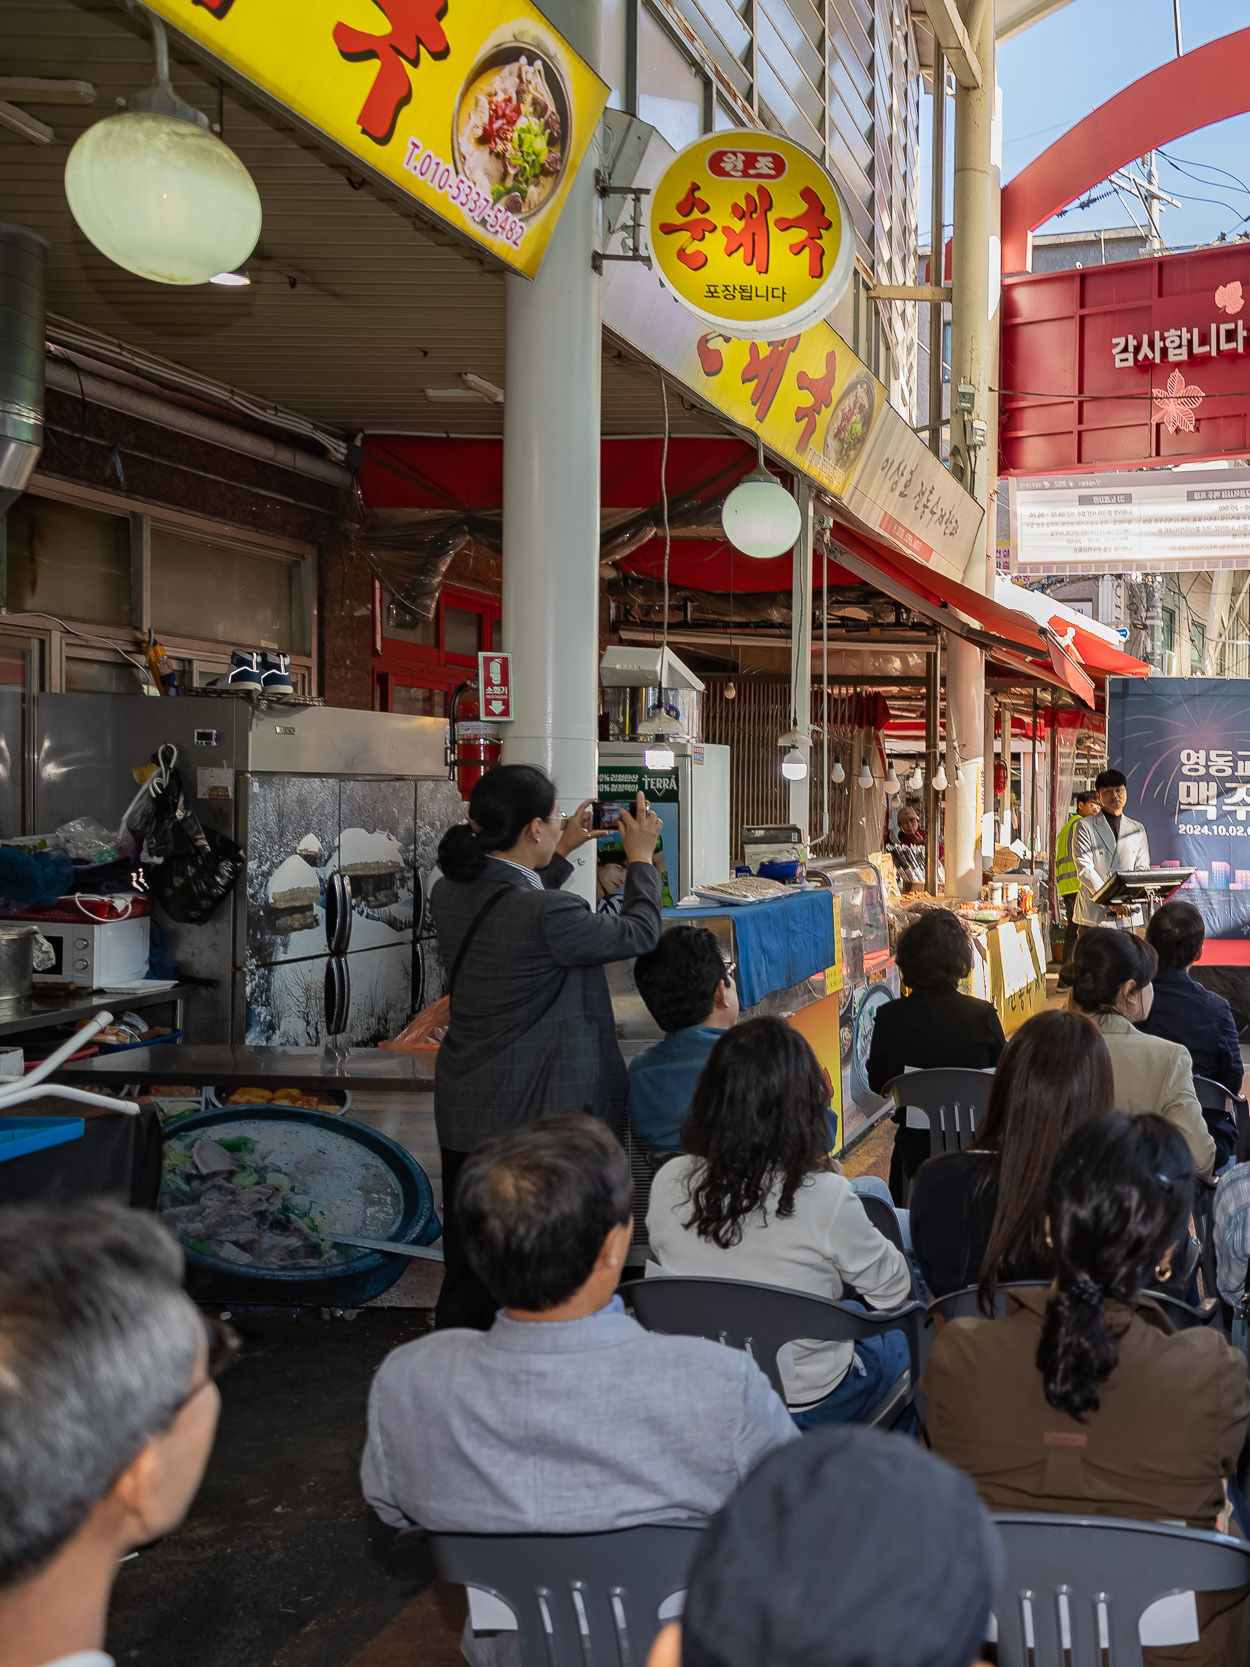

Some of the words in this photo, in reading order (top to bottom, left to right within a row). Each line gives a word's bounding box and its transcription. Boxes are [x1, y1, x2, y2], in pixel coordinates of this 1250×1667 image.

[719, 151, 777, 177] 원조
[402, 136, 526, 249] T.010-5337-5482
[658, 181, 833, 279] 순대국
[704, 283, 787, 302] 포장됩니다
[1111, 319, 1247, 368] 감사합니다
[485, 686, 508, 695] 소화기
[642, 774, 678, 791] TERRA
